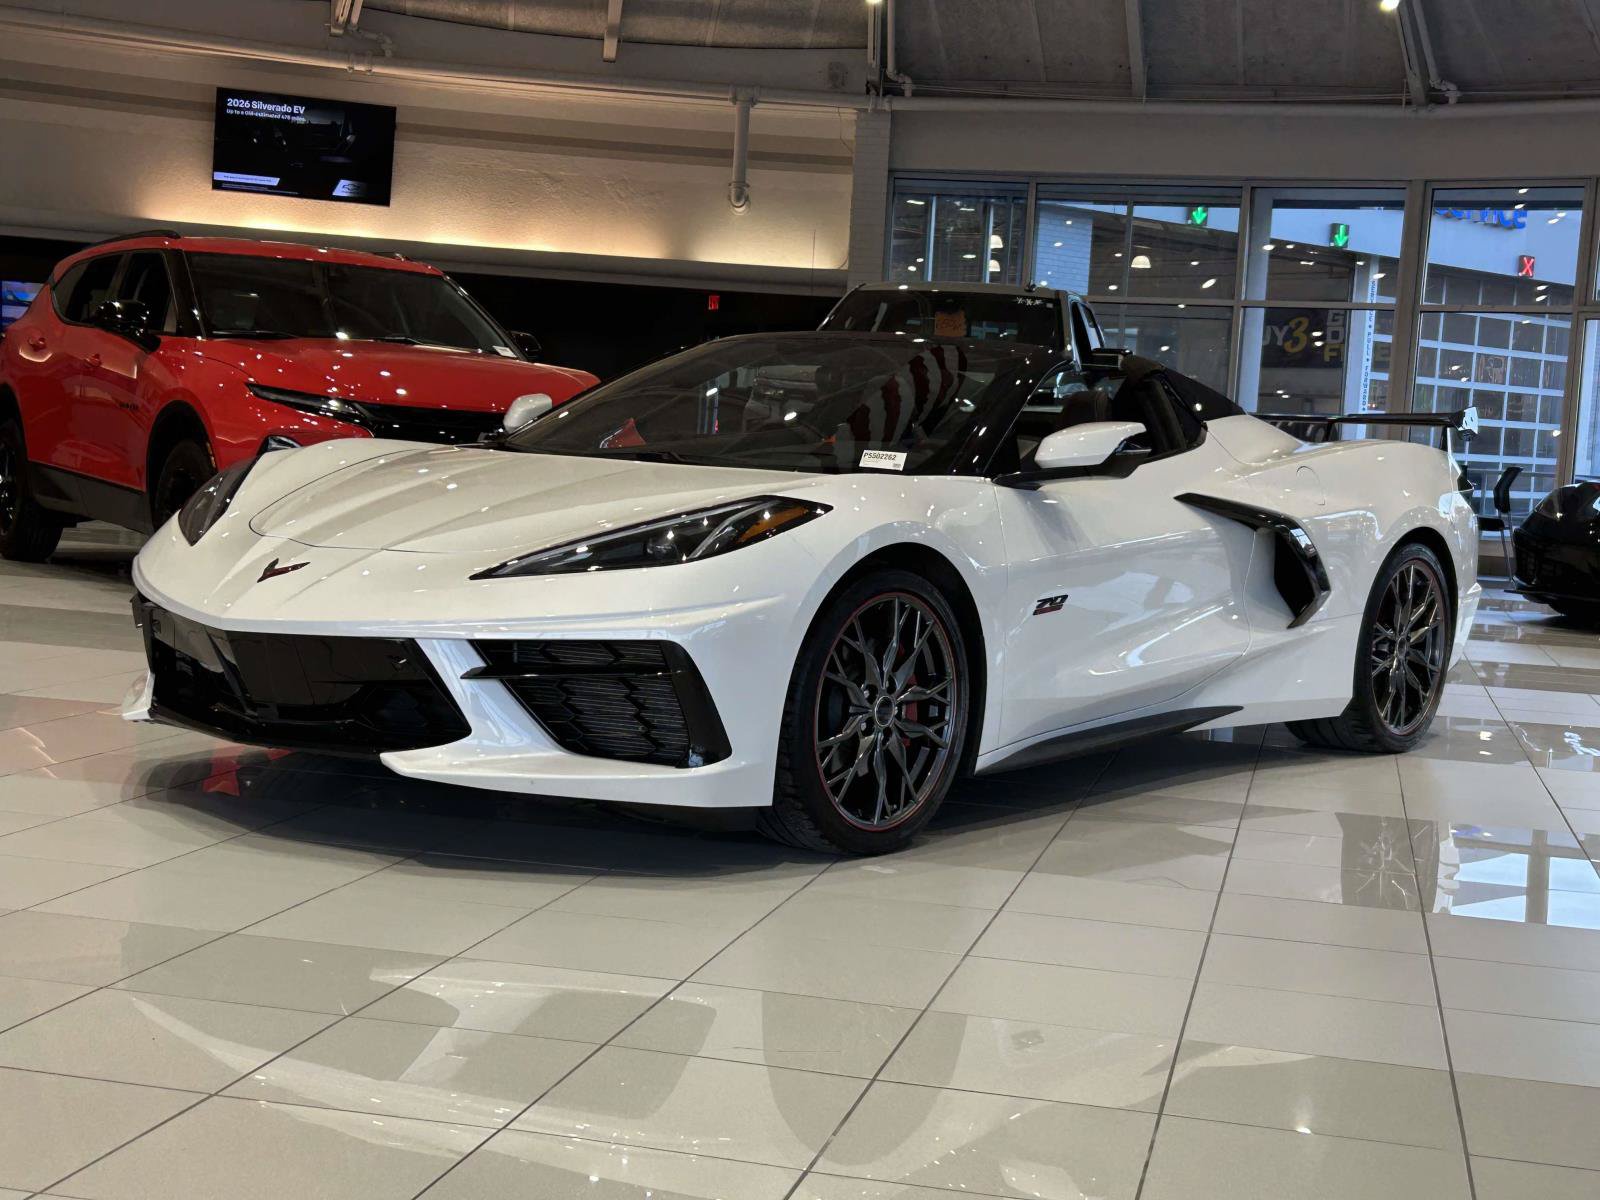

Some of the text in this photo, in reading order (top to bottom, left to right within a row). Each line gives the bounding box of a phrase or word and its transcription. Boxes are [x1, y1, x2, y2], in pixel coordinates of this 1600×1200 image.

[226, 98, 305, 114] 2026 Silverado EV
[1284, 316, 1310, 353] 3
